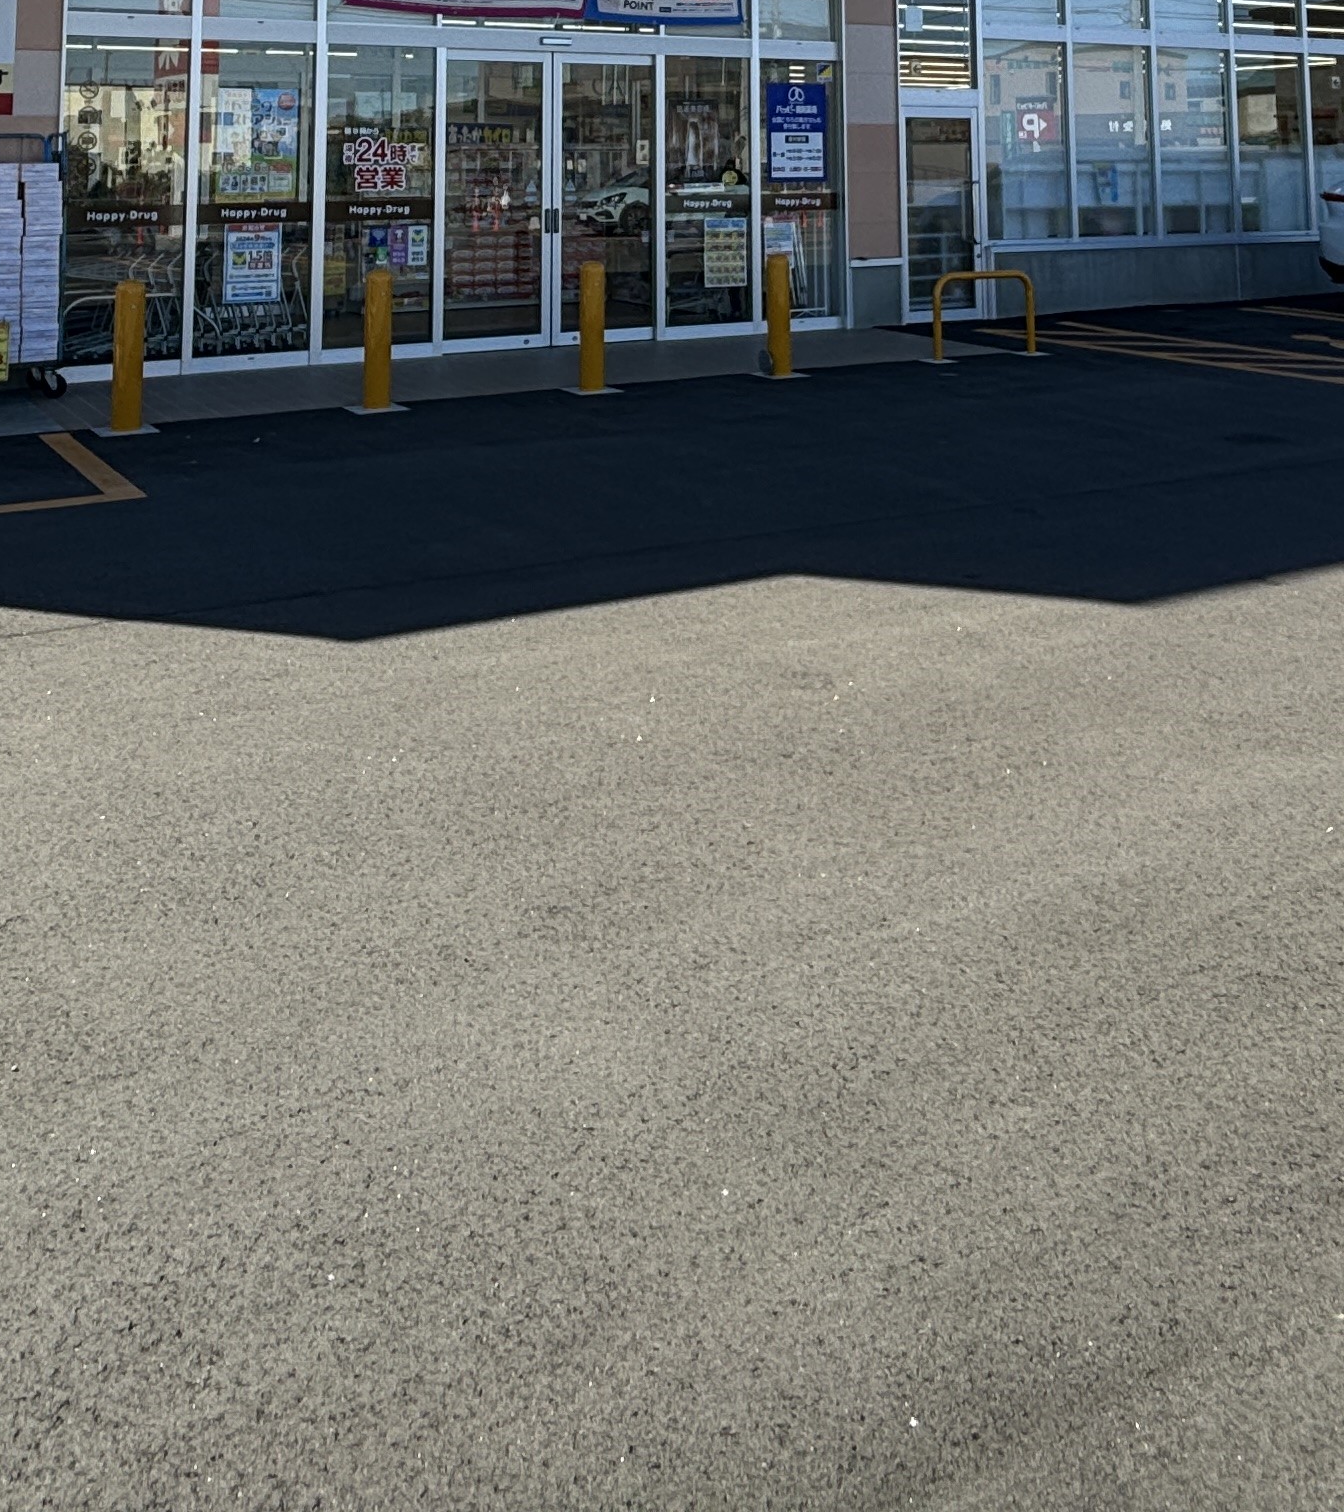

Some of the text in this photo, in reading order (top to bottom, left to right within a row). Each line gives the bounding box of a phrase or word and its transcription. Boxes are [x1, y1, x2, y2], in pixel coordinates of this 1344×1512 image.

[623, 1, 654, 11] POINT
[356, 138, 407, 164] 24時
[355, 167, 406, 191] 営業
